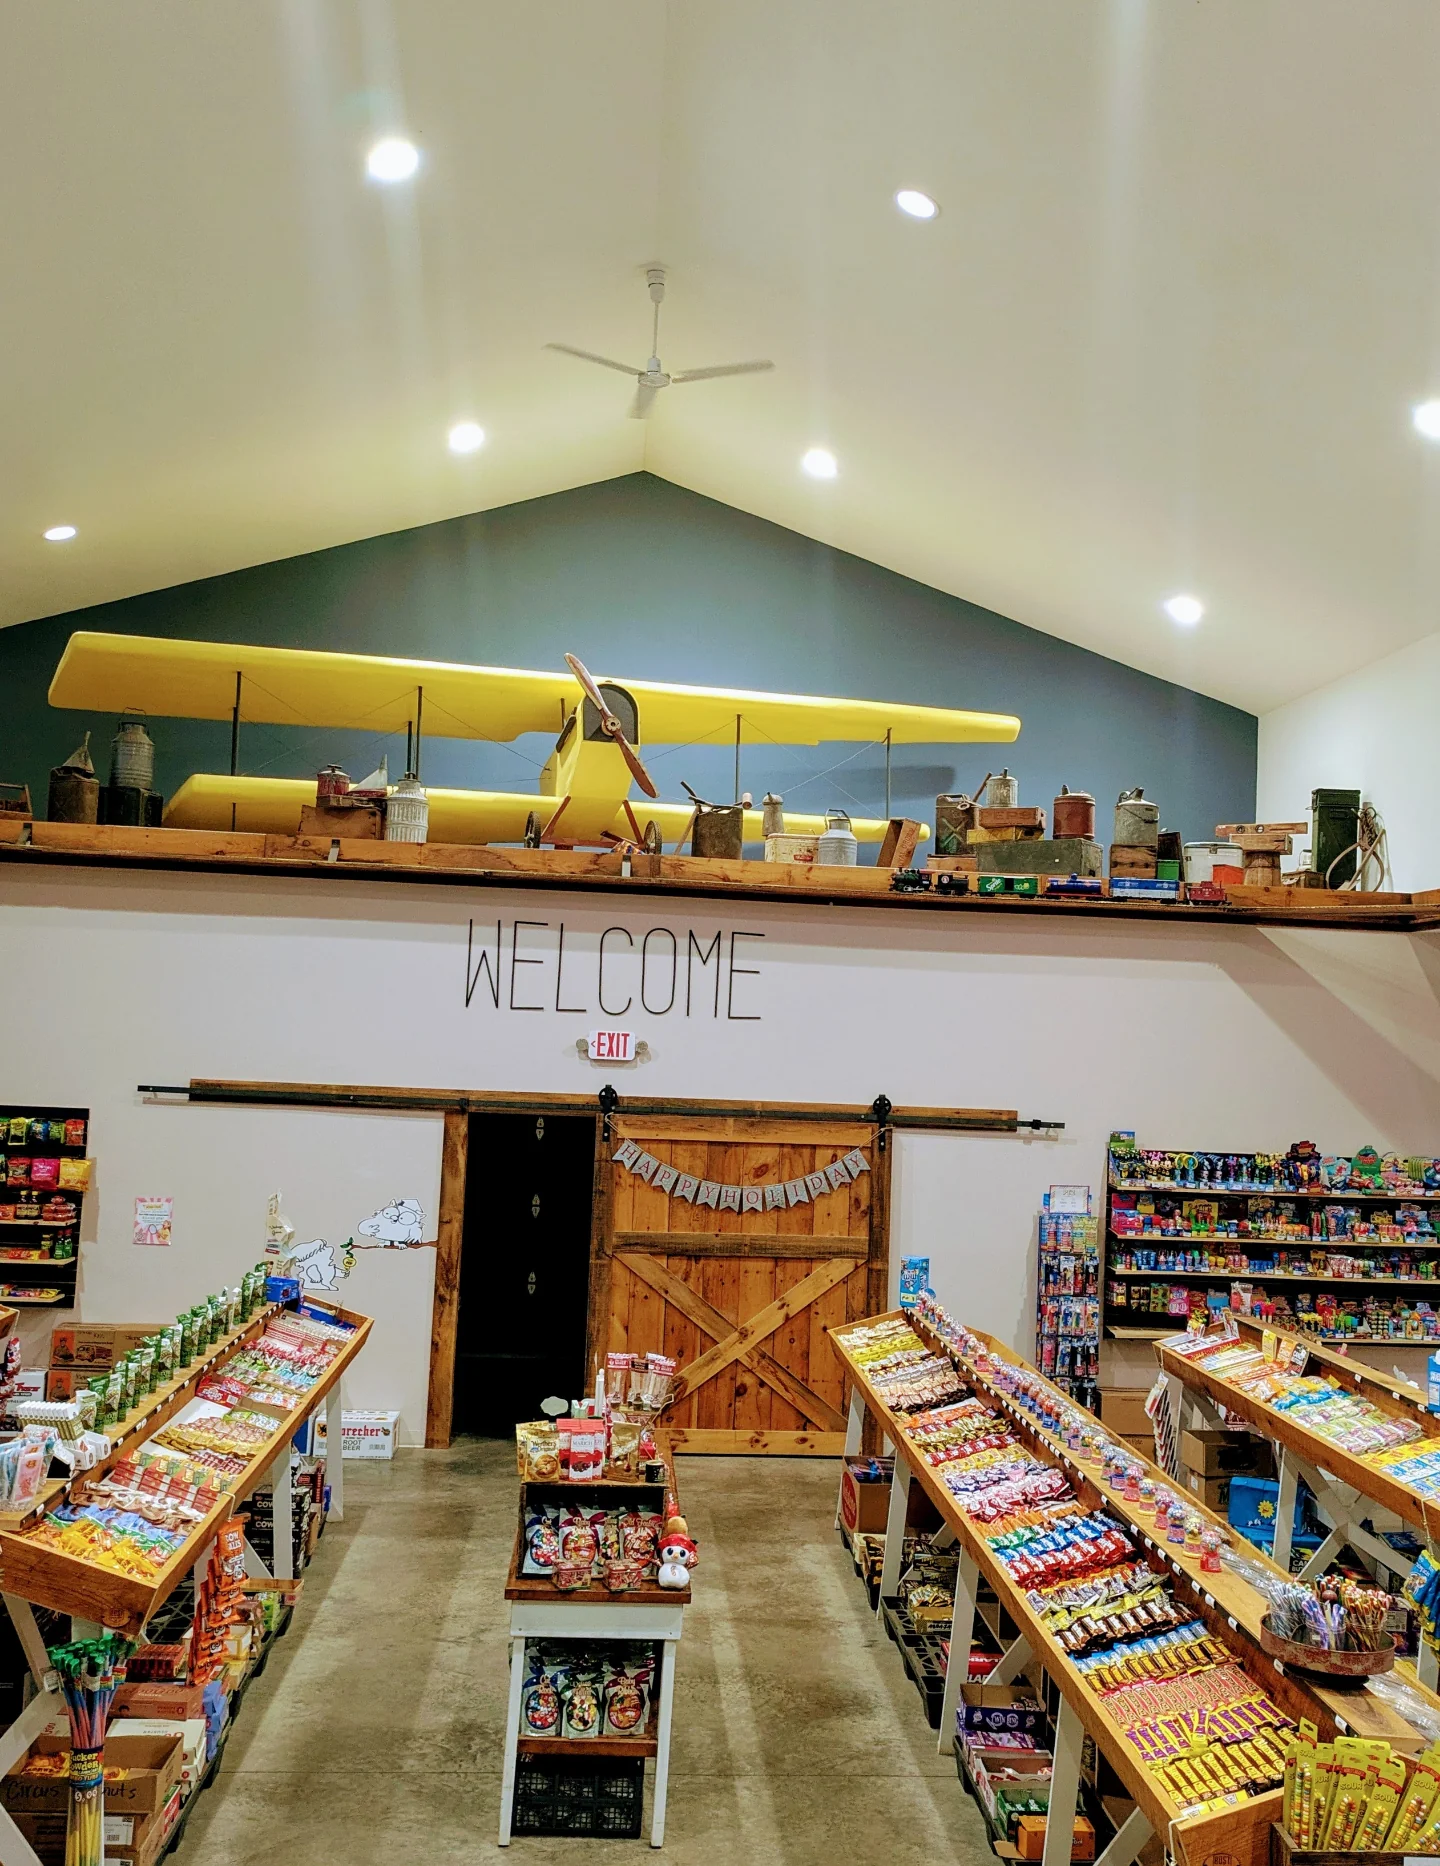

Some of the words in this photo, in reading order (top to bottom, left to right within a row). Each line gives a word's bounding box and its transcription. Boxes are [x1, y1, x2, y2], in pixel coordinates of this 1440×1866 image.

[465, 918, 765, 1020] WELCOME
[597, 1032, 630, 1058] EXIT
[342, 1424, 381, 1437] recher
[6, 1780, 61, 1801] Circus
[102, 1783, 136, 1800] nuts
[1340, 1782, 1363, 1791] SOUR
[1413, 1779, 1436, 1791] SOUR
[1373, 1793, 1397, 1804] SOUR
